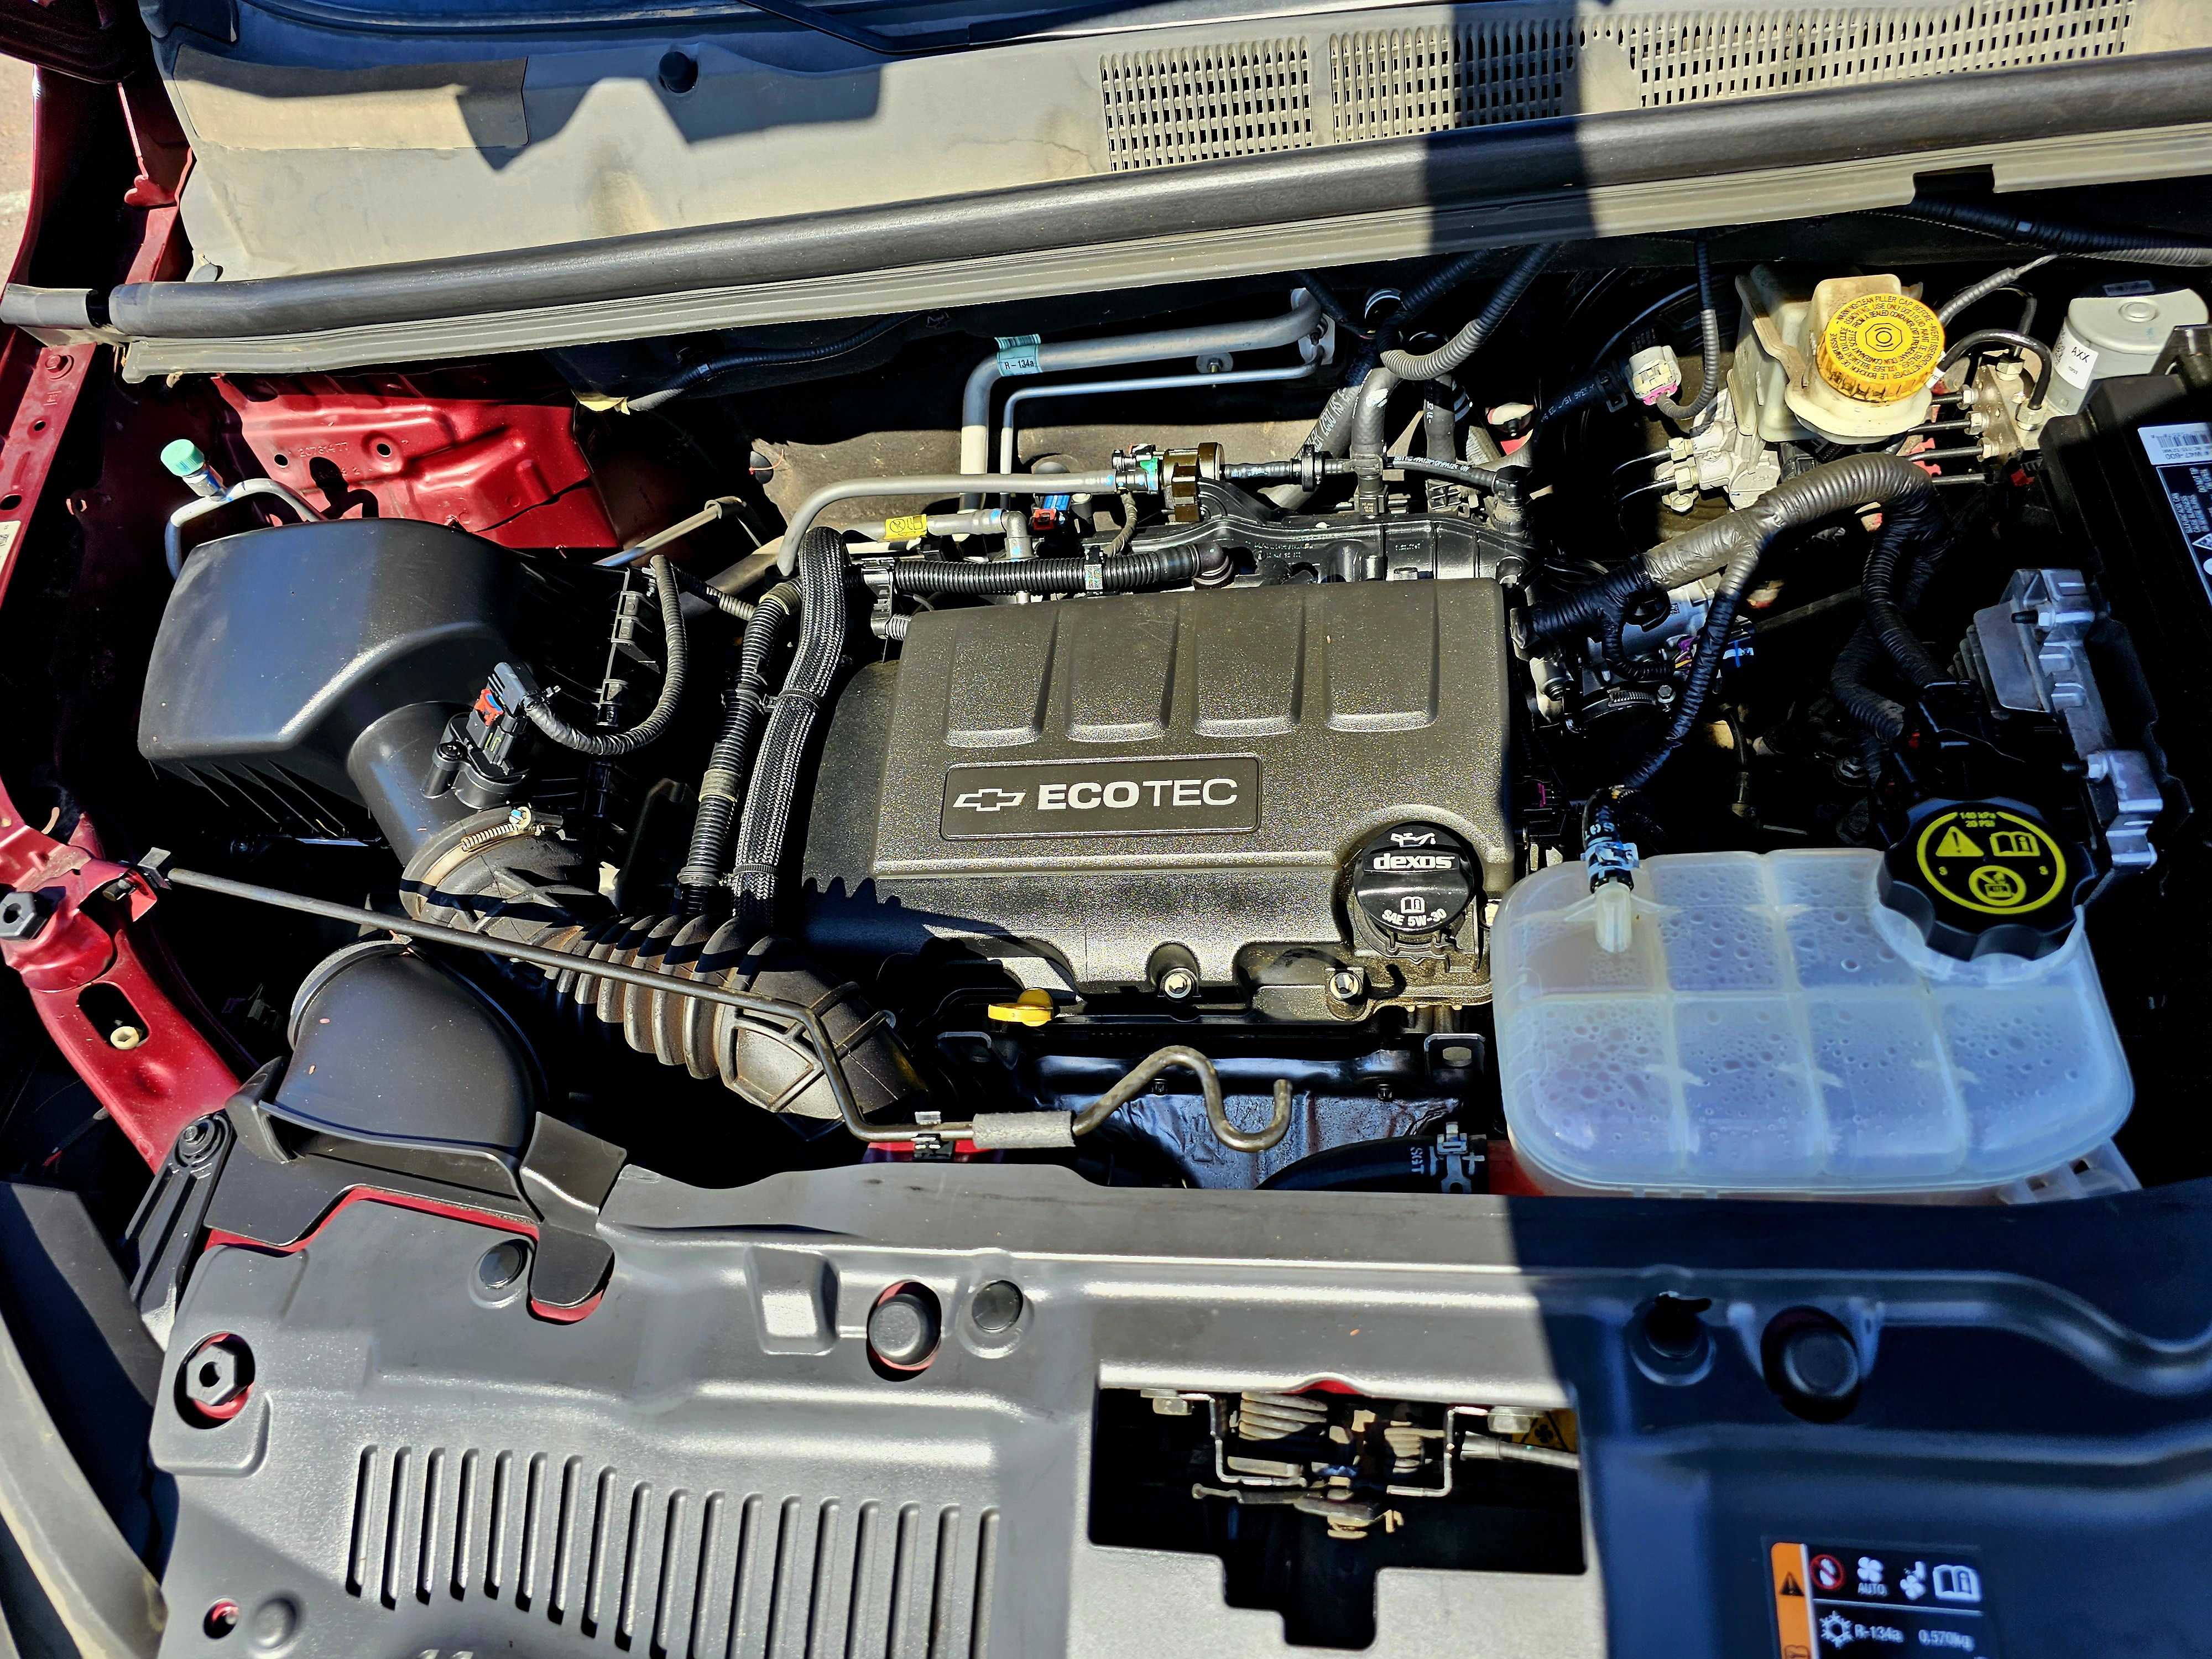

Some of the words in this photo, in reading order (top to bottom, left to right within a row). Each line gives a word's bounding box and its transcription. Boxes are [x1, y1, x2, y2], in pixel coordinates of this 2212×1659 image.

[1898, 298, 1914, 307] CAP
[1912, 305, 1933, 321] BEFORE
[2071, 346, 2090, 363] AXX
[1037, 778, 1238, 810] ECOTEC
[1374, 853, 1455, 870] dexos
[1381, 909, 1405, 926] SAE
[1407, 908, 1447, 926] 5W-30
[1854, 1623, 1904, 1644] R-134a
